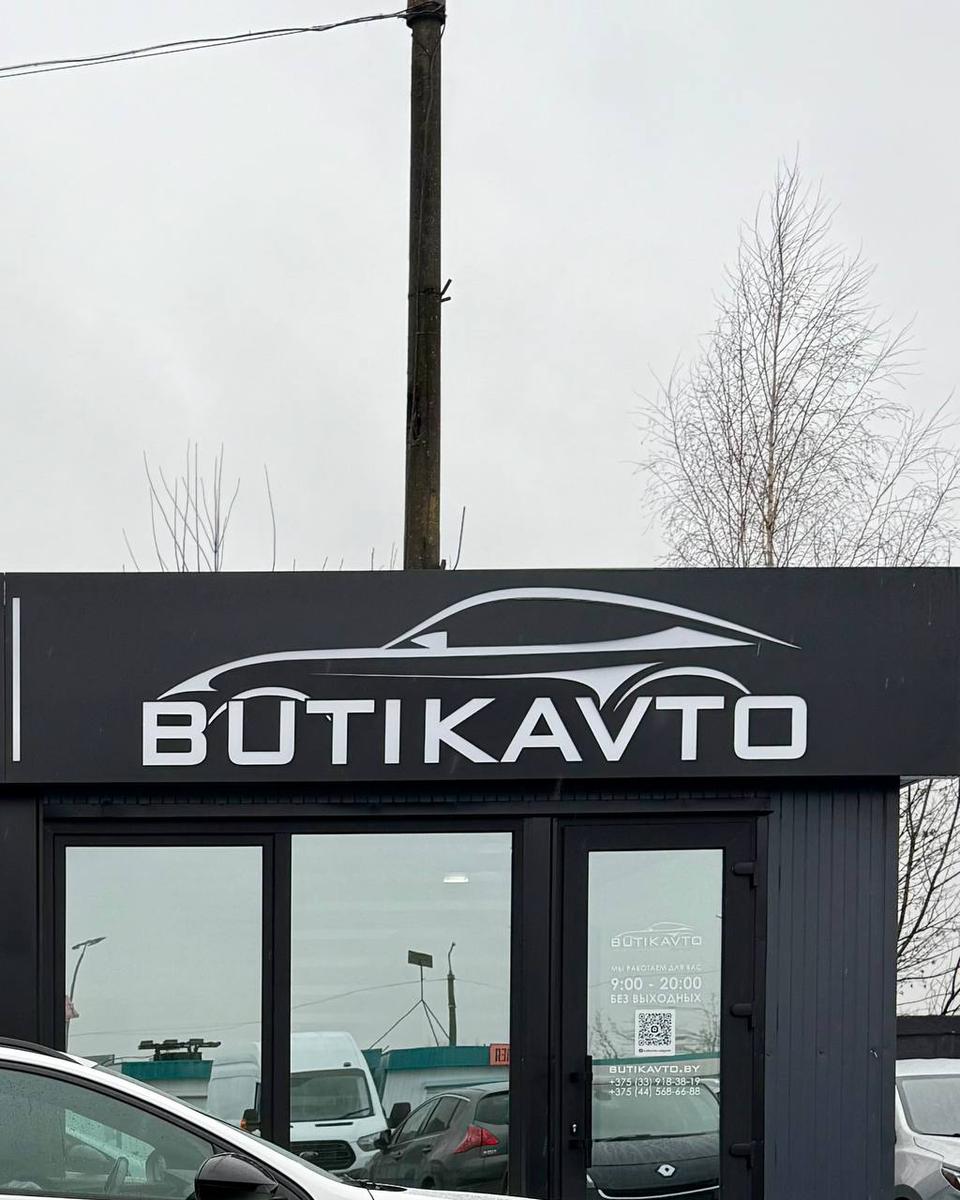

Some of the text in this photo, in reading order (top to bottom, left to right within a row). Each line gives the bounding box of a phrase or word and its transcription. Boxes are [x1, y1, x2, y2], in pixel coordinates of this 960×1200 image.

[142, 695, 808, 766] BUTIKAVTO
[611, 936, 702, 947] BUTIKAVTO
[611, 977, 643, 991] 9:00
[660, 976, 702, 990] 20:00
[610, 993, 702, 1004] БЕЗ ВЫХОДНЫХ
[609, 1065, 701, 1074] BUTIKAVTO.BY
[609, 1077, 701, 1088] +375 (33) 918-38-19
[609, 1087, 701, 1097] +375 (44) 568-66-88
